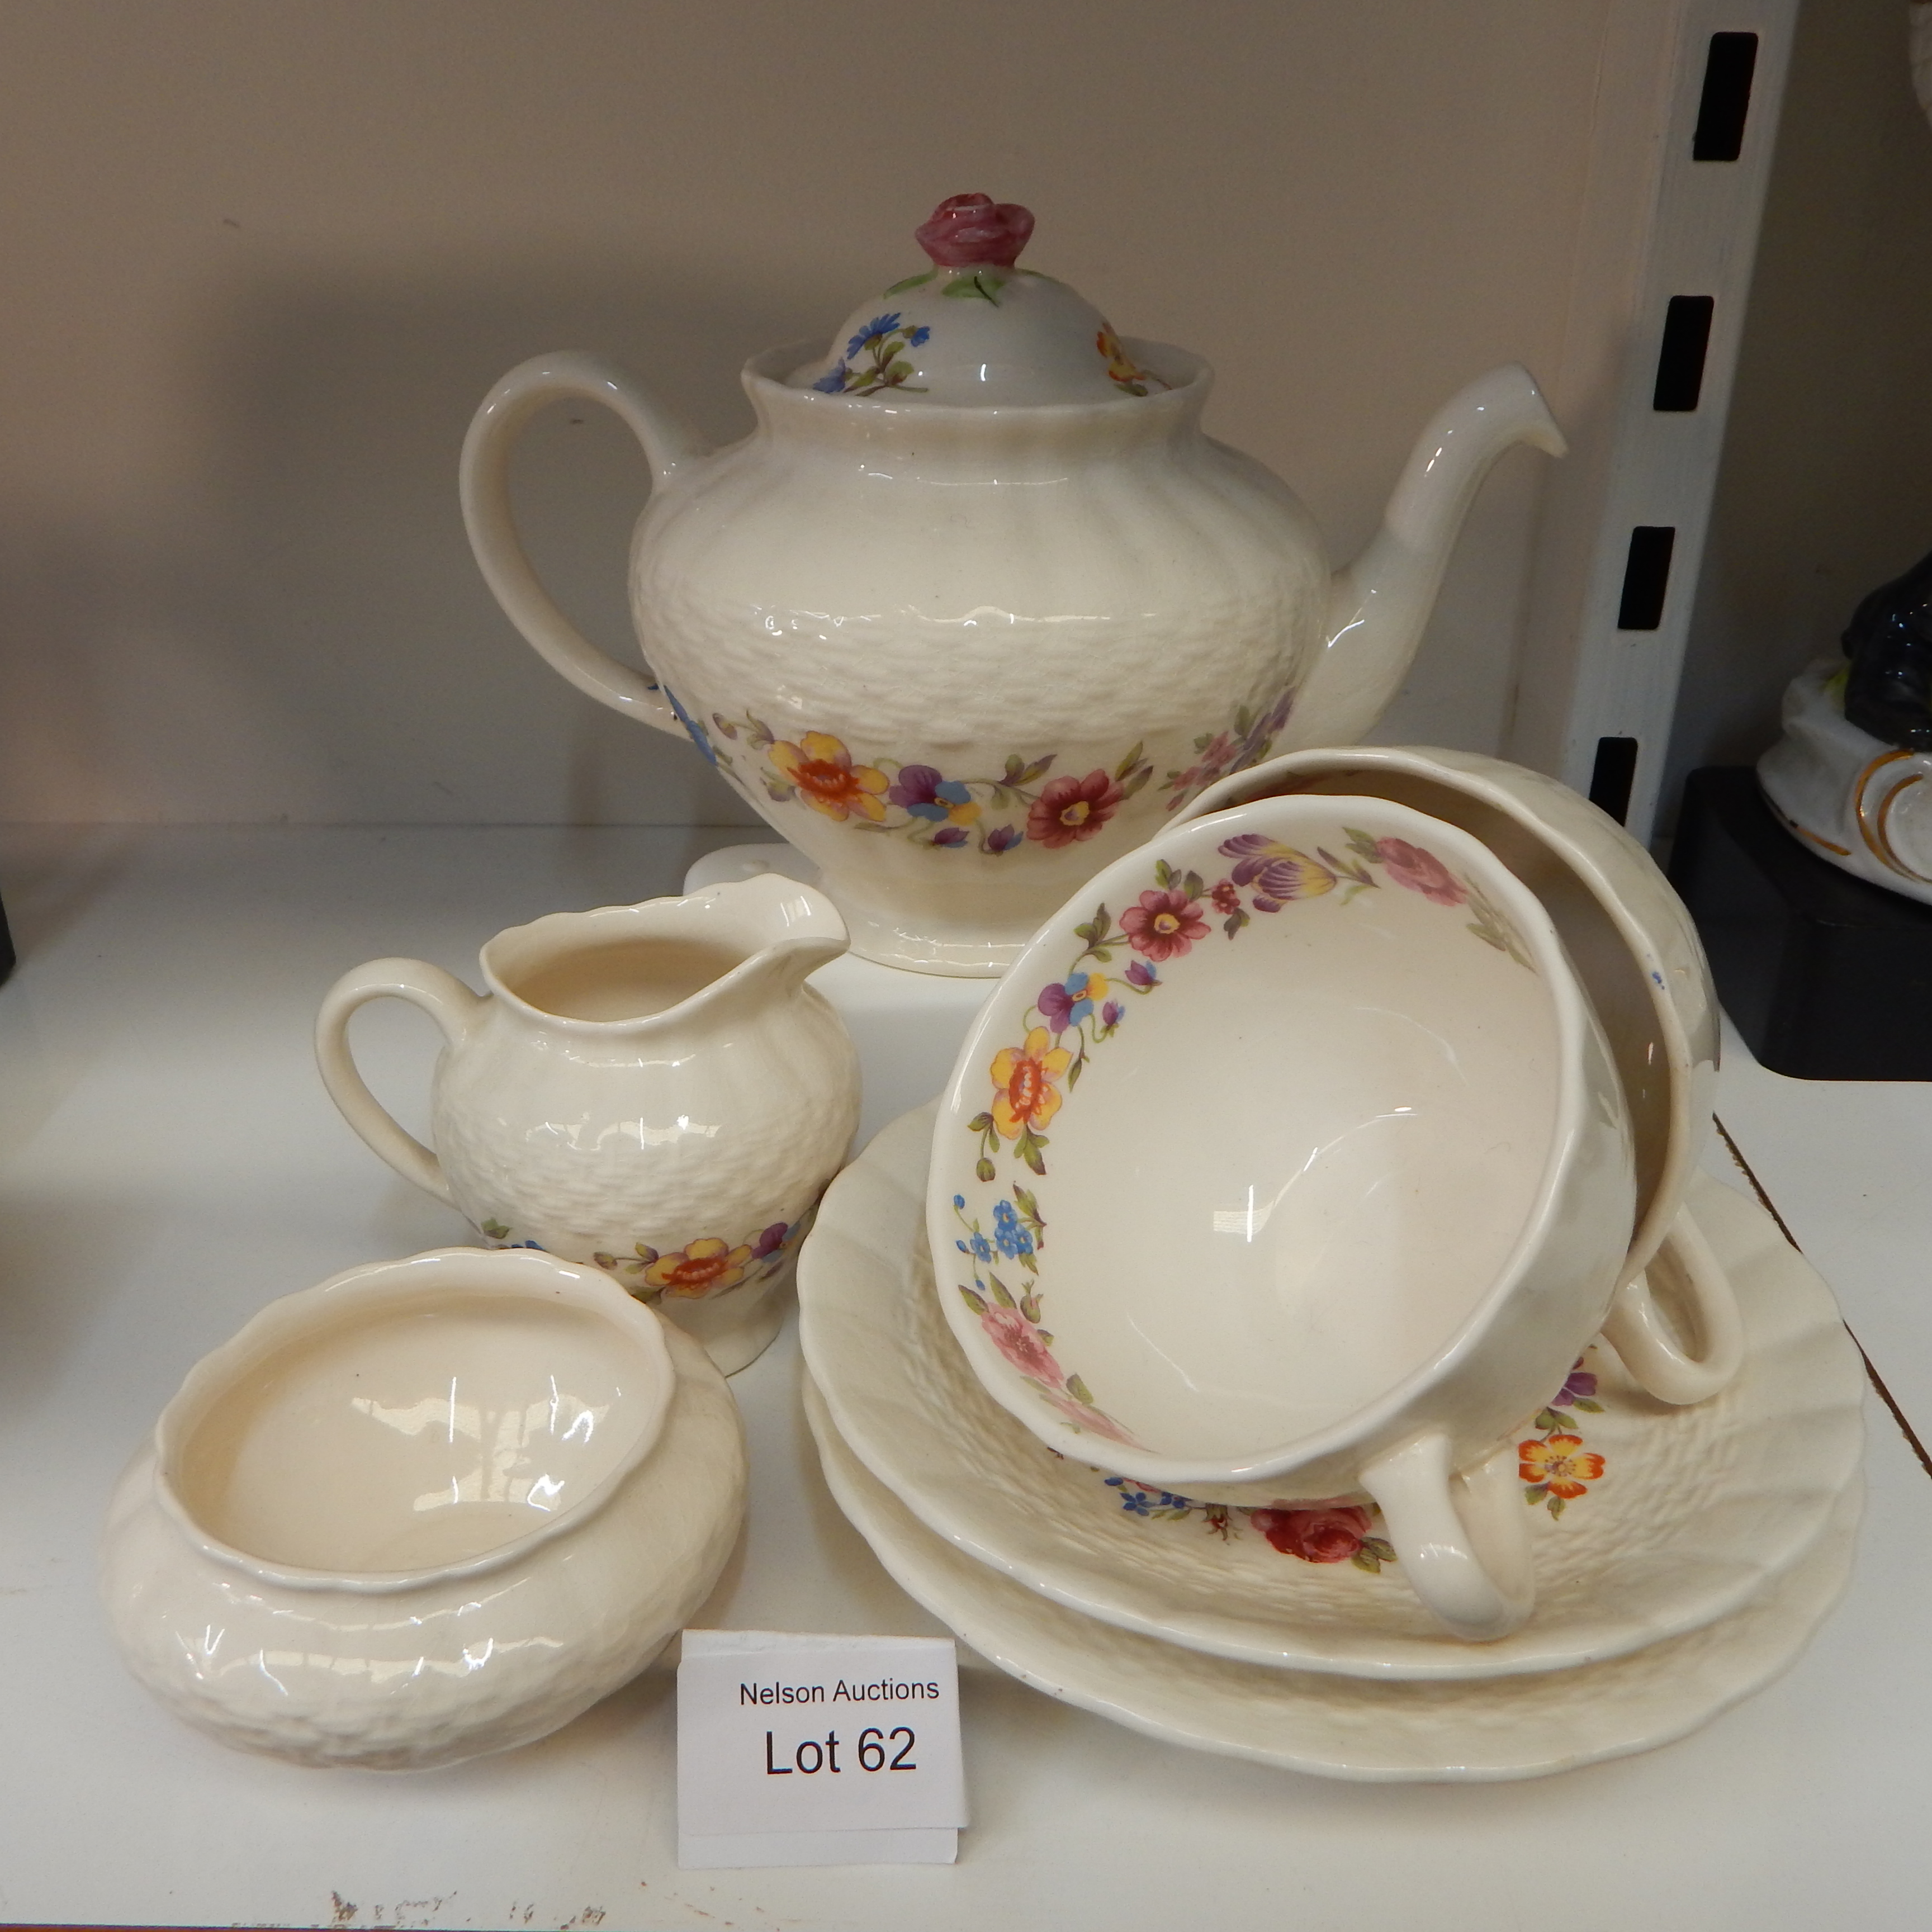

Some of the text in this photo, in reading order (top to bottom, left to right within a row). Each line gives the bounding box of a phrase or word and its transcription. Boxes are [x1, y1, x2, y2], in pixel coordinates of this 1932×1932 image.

[740, 1678, 940, 1706] Nelson Auctions
[766, 1726, 917, 1775] Lot 62
